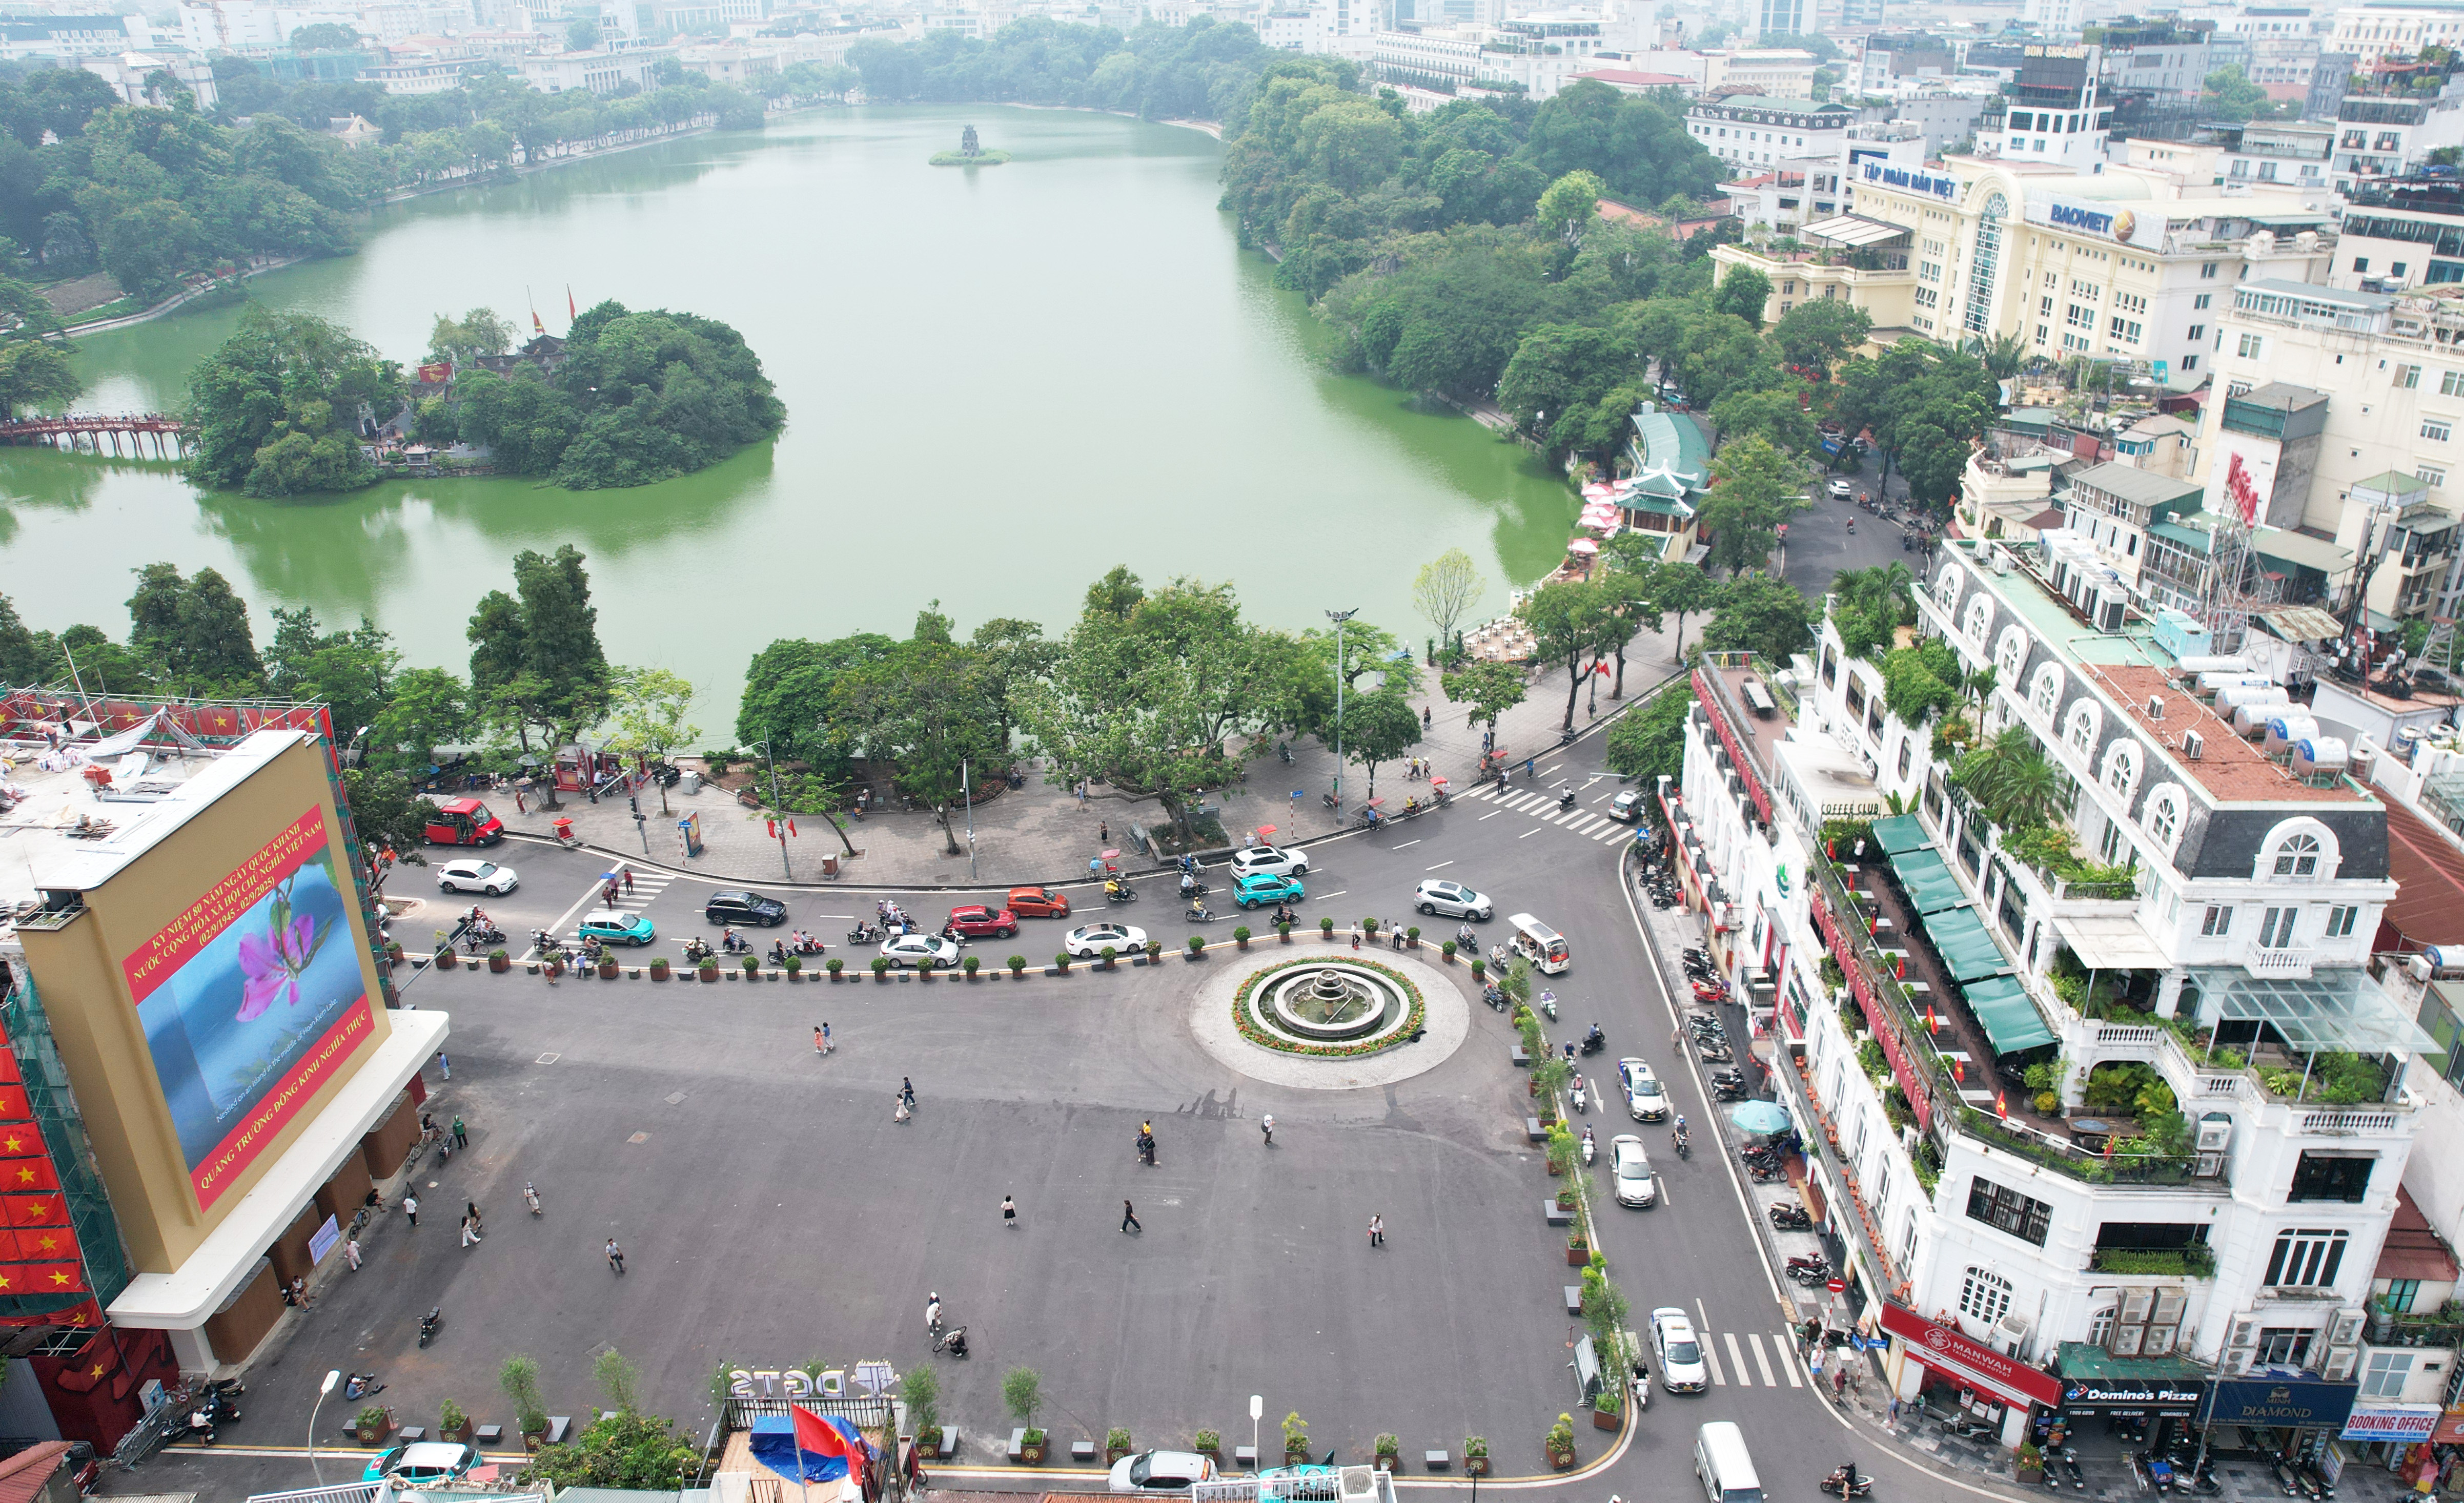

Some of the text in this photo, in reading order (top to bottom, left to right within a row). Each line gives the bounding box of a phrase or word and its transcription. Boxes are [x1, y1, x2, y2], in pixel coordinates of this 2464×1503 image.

[2024, 45, 2085, 59] BON SKY BAR
[1821, 803, 1879, 814] COFFEE CLUB
[167, 911, 192, 938] NIỆM
[192, 903, 202, 917] 80
[202, 886, 223, 908] NĂM
[223, 865, 247, 891] NGÀY
[249, 847, 272, 871] QUỐC
[272, 823, 300, 852] KHÁNH
[133, 953, 162, 982] NƯỚC
[164, 930, 190, 957] CỘNG
[190, 914, 211, 935] HÒA
[211, 900, 223, 918] XÃ
[224, 888, 241, 907] HỘI
[241, 871, 259, 892] CHỦ
[286, 835, 303, 855] VIỆT
[304, 820, 322, 841] NAM
[199, 908, 235, 946] (02/9/1945
[240, 876, 275, 910] 02/9/2025)
[216, 999, 338, 1123] Nestled on an island in the middle of Hoan Kiem Lake,
[201, 1010, 366, 1189] QUẢNG TRƯỜNG ĐÔNG KINH NGHĨA THỤC
[1952, 1349, 2010, 1378] TAIWANESE HOTPOT
[1953, 1342, 2012, 1373] MANWAH
[2087, 1389, 2198, 1401] Domino's Pizza
[2242, 1406, 2312, 1418] DIAMOND
[2348, 1415, 2396, 1430] BOOKING
[2397, 1417, 2435, 1431] OFFICE
